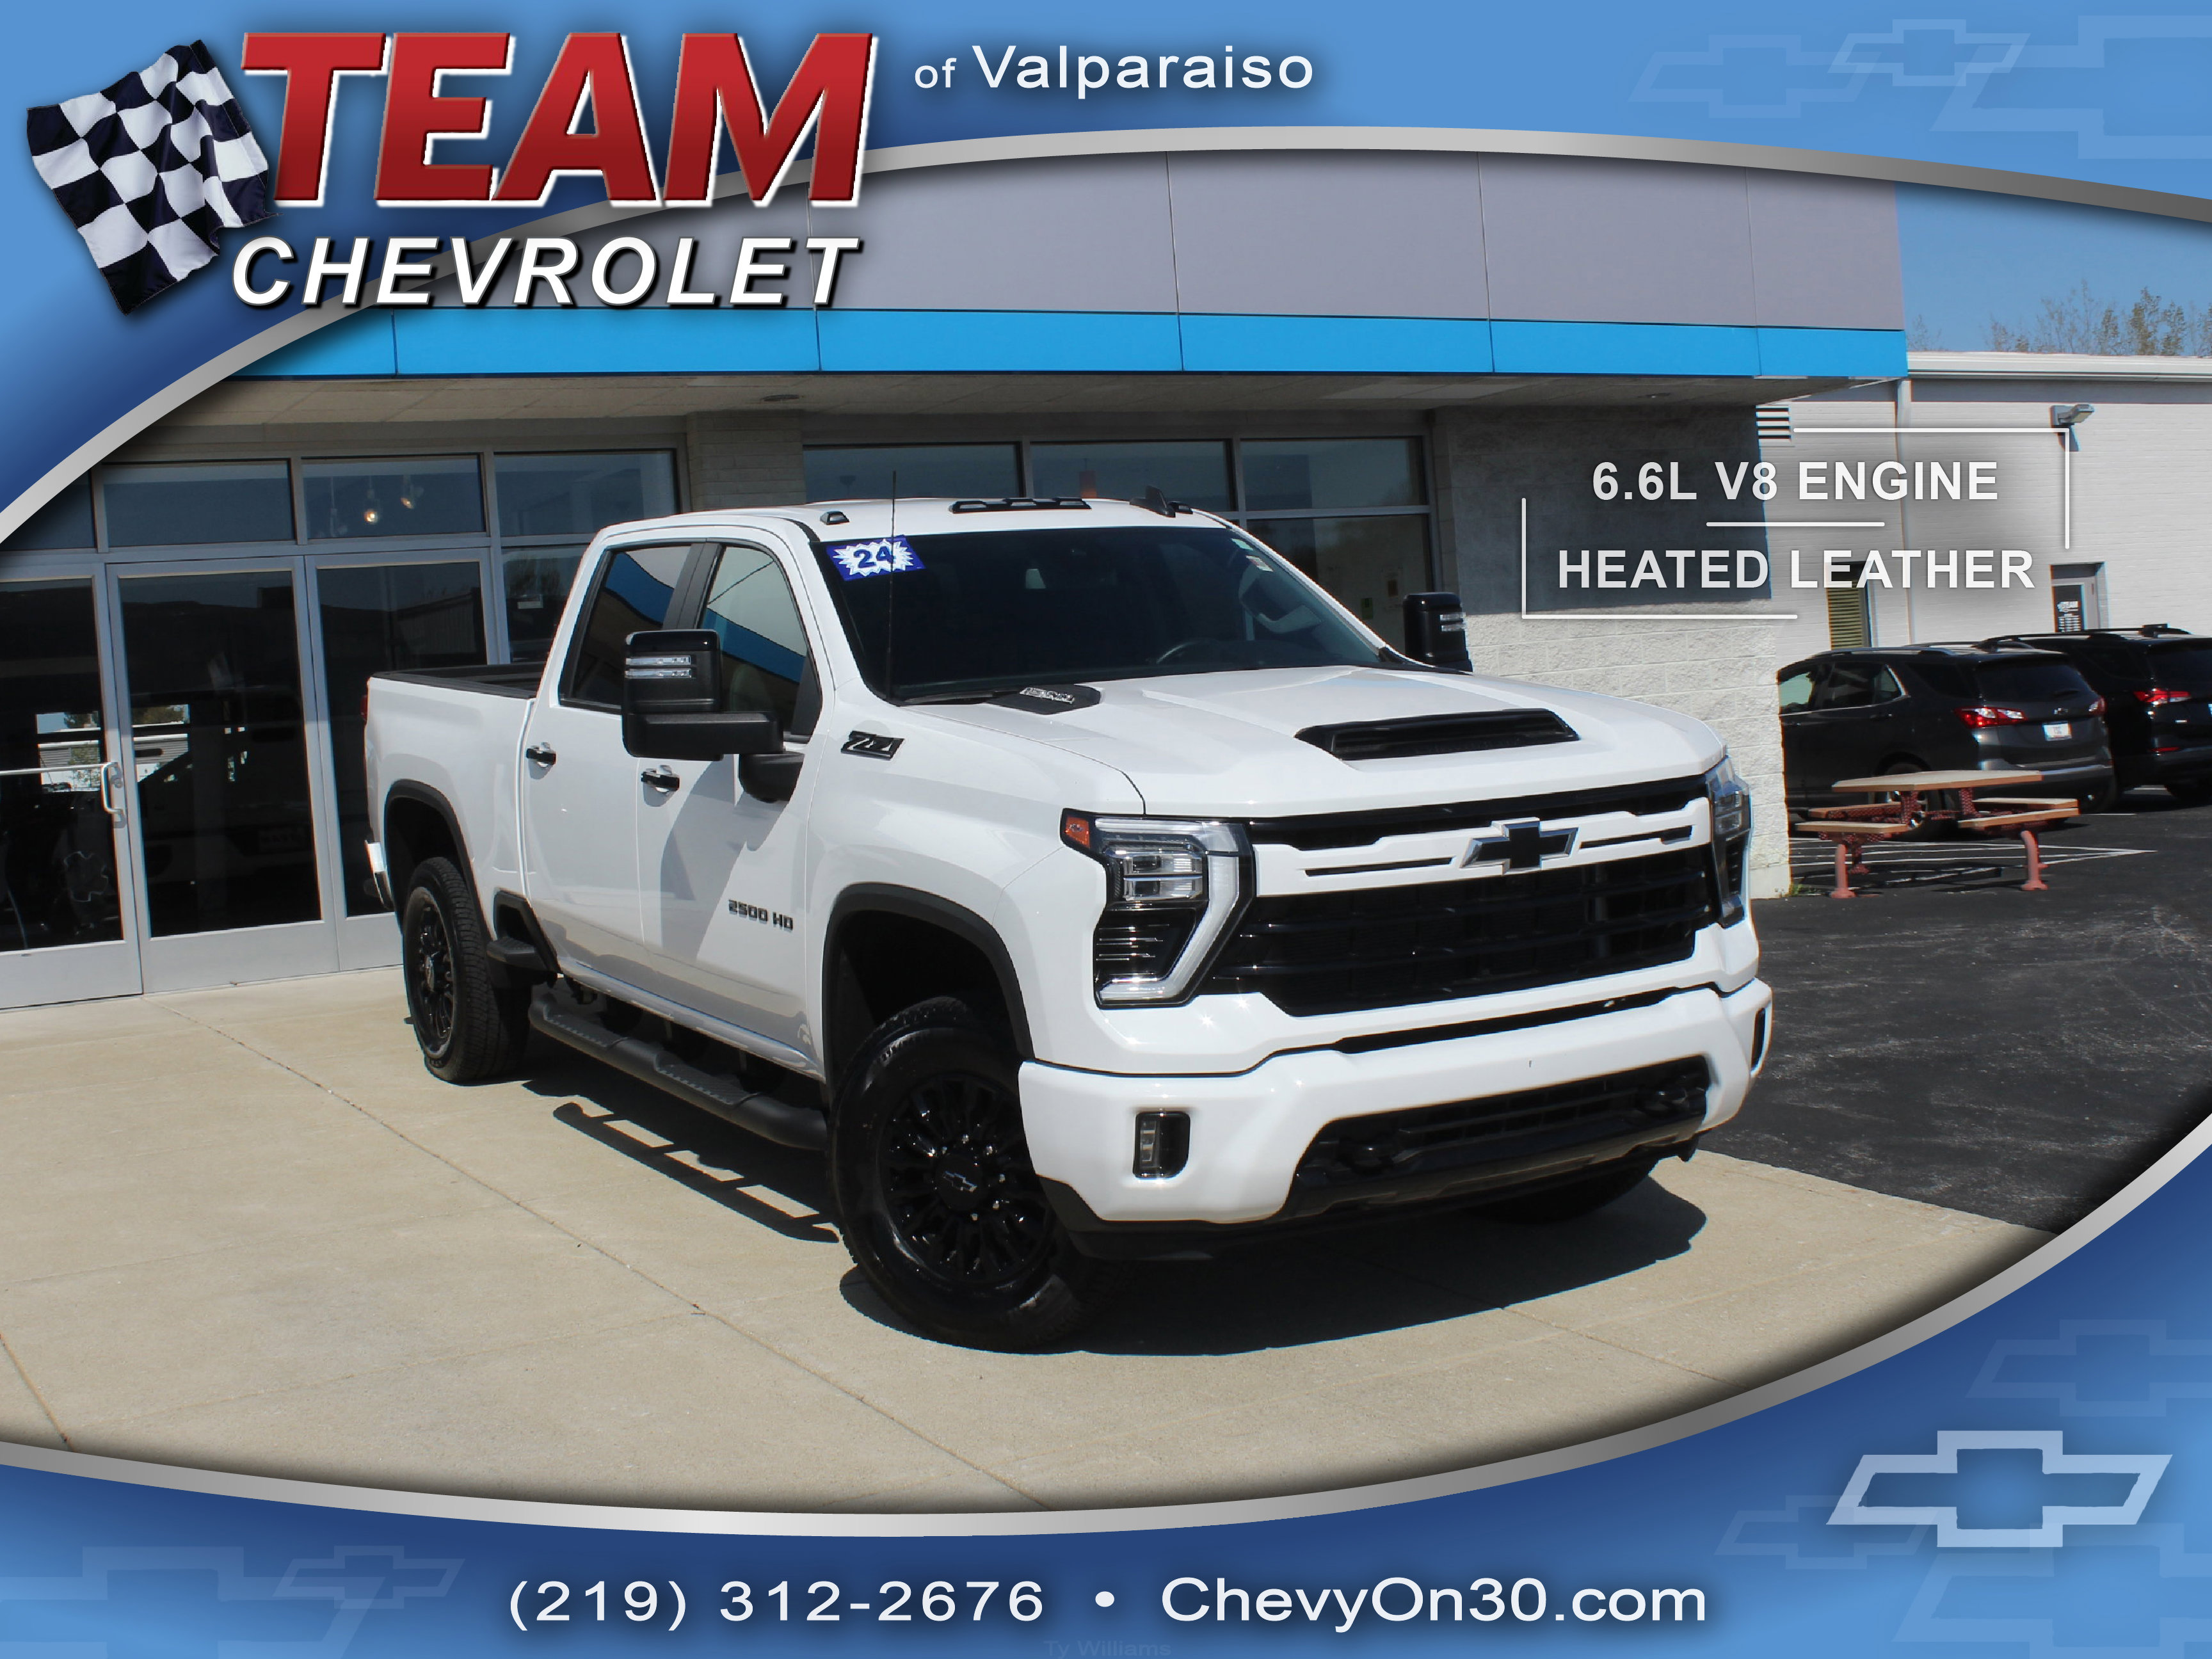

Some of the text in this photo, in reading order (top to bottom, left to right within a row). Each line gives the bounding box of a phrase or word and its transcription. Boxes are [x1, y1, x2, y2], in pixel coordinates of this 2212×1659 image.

[853, 546, 895, 568] 24
[728, 899, 794, 931] 2500 HD
